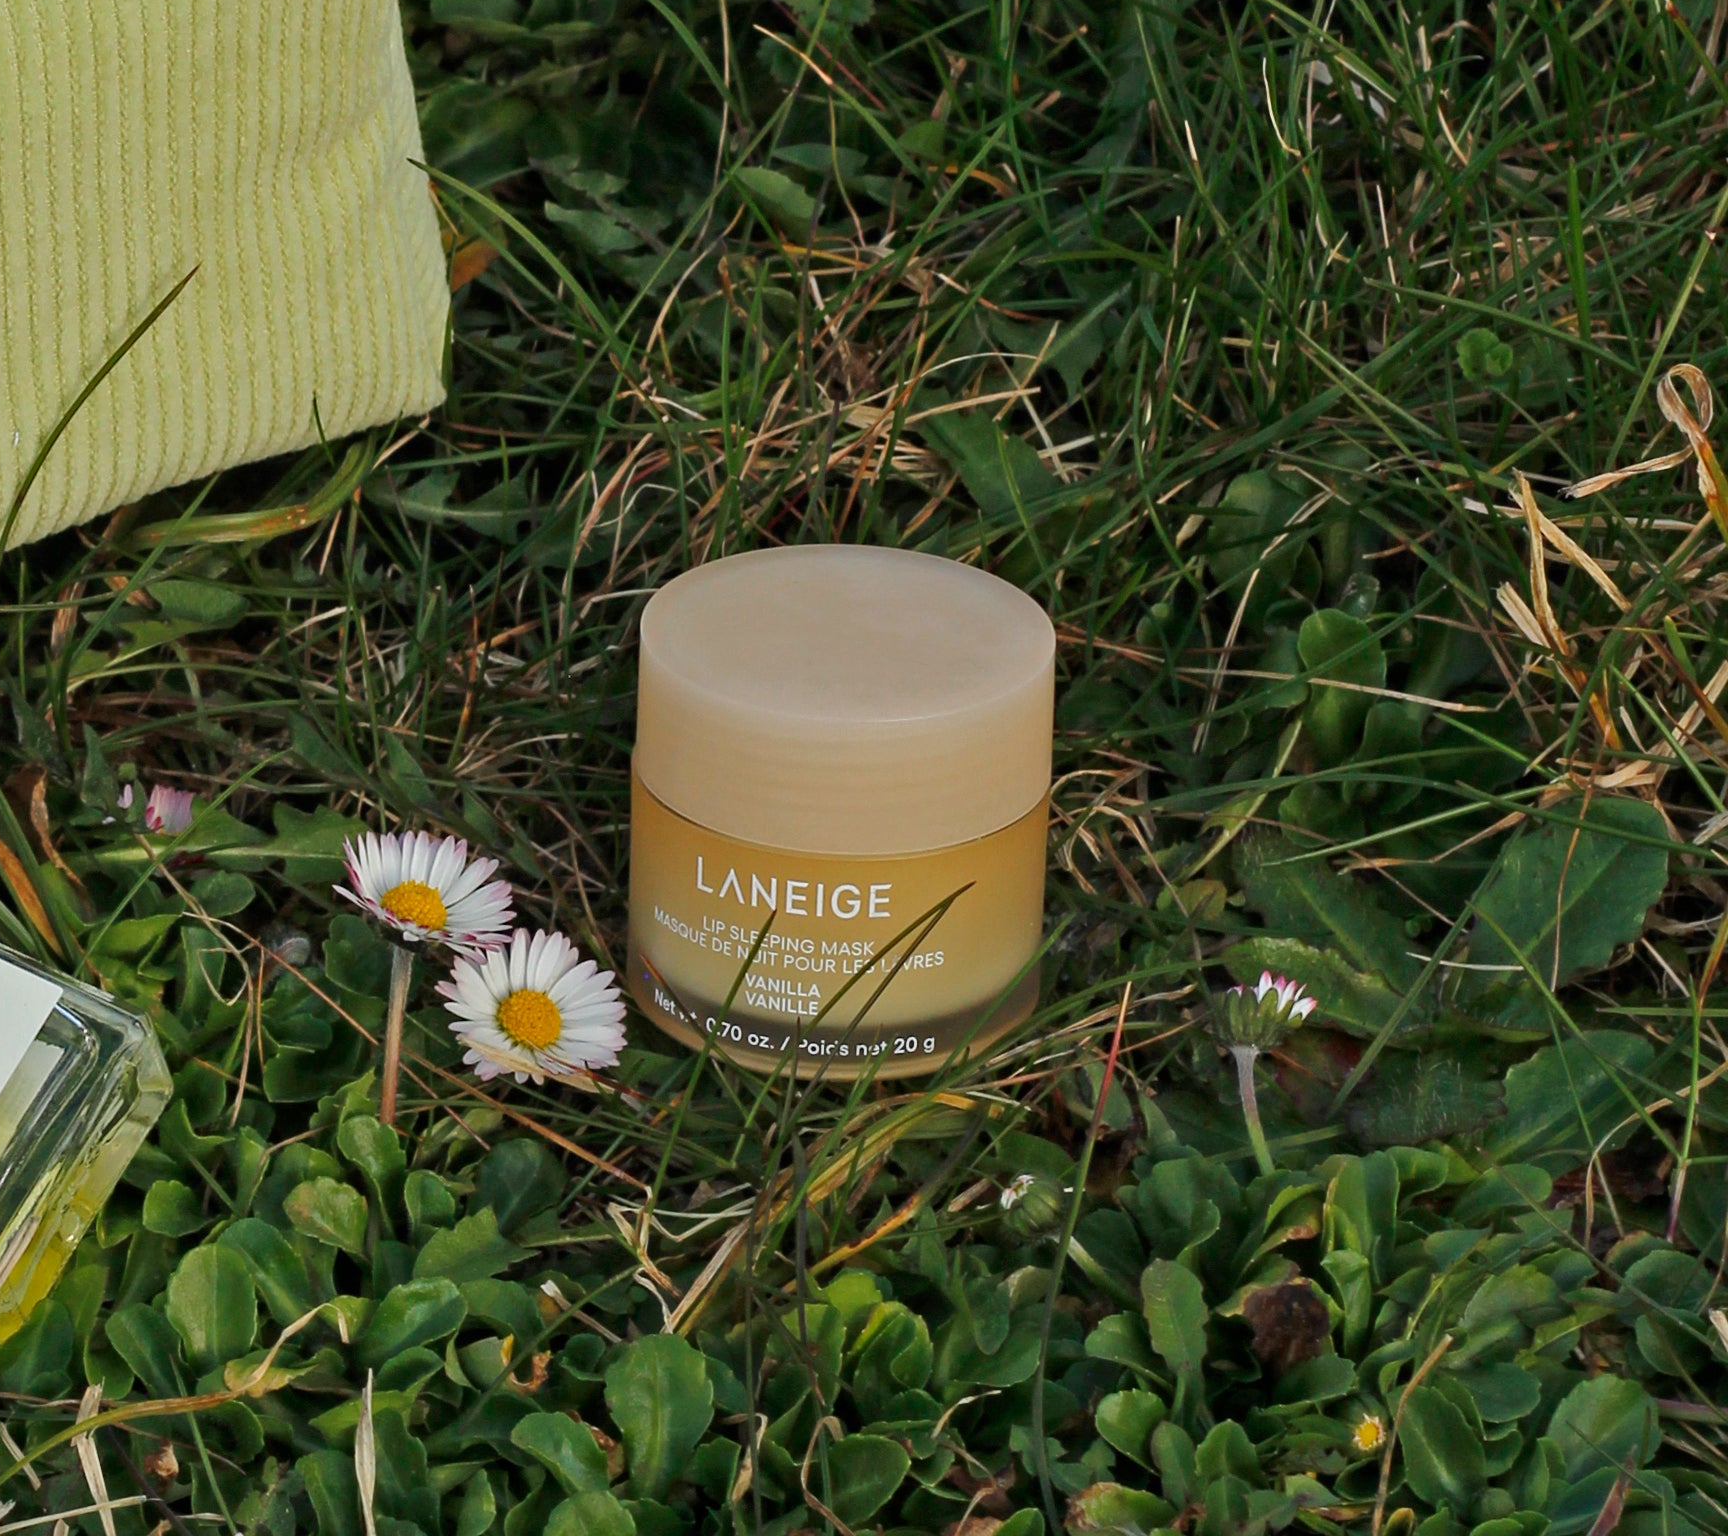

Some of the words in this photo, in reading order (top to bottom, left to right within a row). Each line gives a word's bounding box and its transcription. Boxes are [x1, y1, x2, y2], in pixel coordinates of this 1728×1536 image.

[696, 855, 892, 919] LANEIGE
[654, 905, 707, 948] MASQUE
[711, 937, 732, 956] DE
[784, 954, 837, 974] POUR
[881, 951, 945, 974] LVRES
[702, 916, 726, 935] LIP
[821, 941, 875, 956] MASK
[745, 972, 821, 998] VANILLA
[745, 990, 819, 1016] VANILLE
[654, 988, 676, 1016] Net
[747, 1033, 775, 1050] oz.
[893, 1036, 918, 1054] 20
[923, 1036, 935, 1053] g
